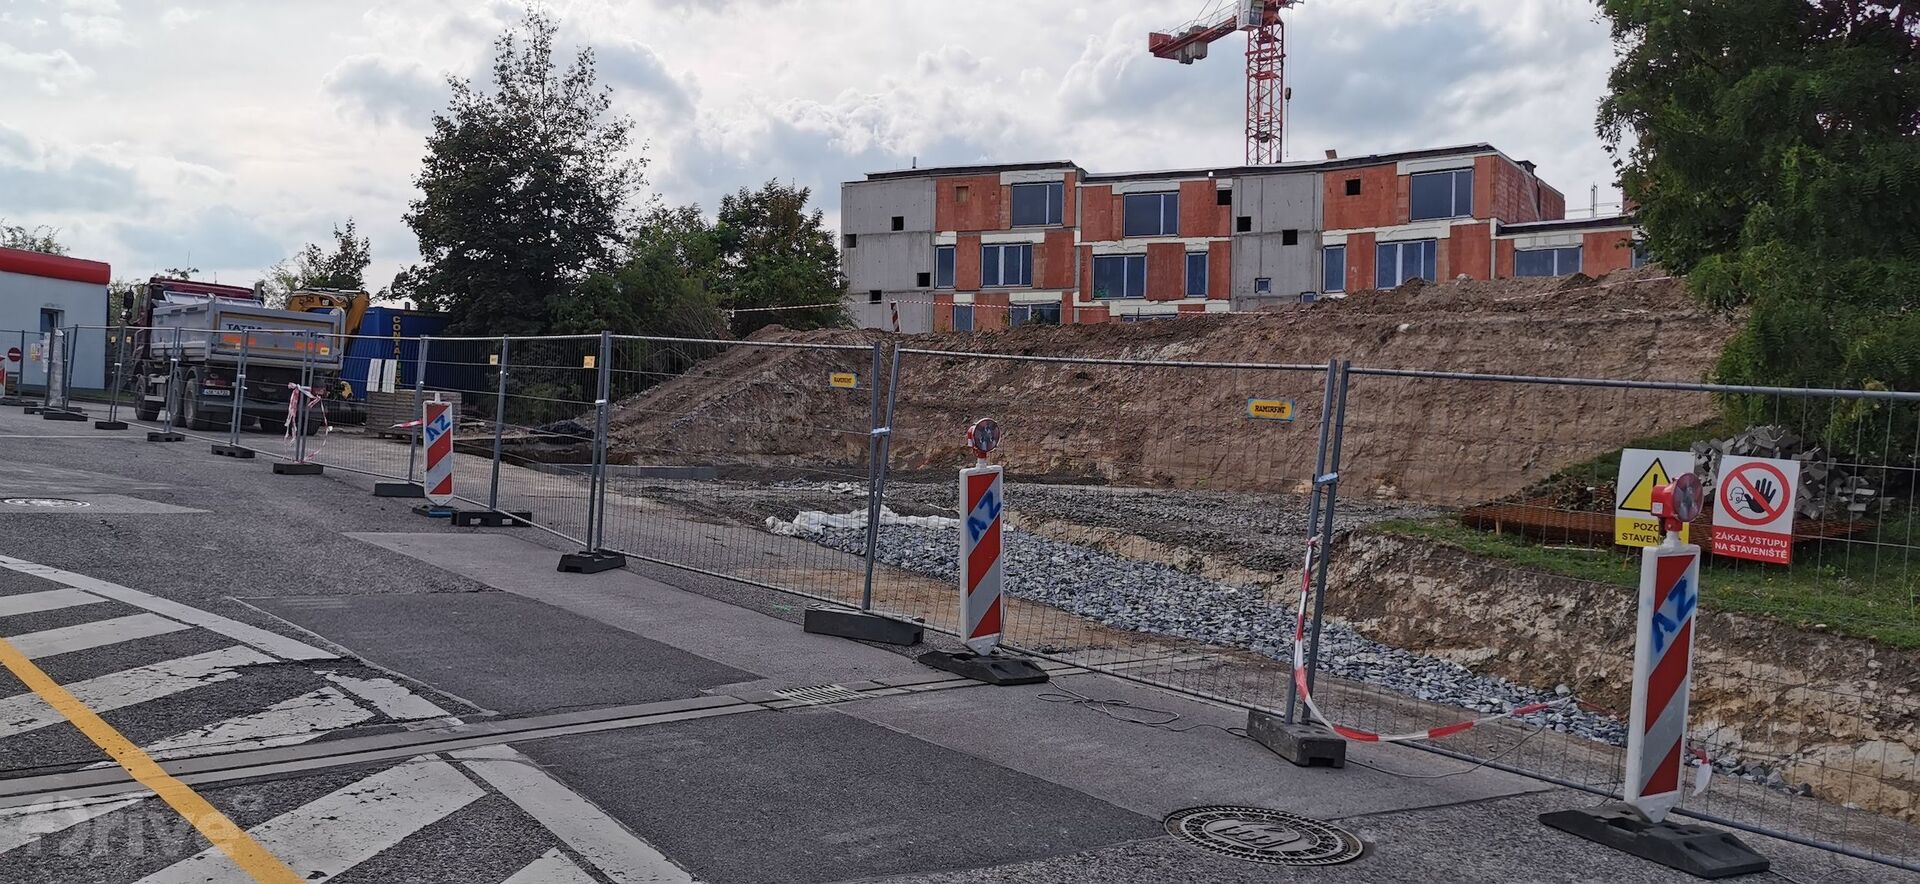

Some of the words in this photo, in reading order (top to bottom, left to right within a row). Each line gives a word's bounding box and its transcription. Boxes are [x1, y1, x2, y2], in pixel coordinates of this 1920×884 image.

[967, 489, 1001, 542] AZ
[1633, 522, 1660, 532] POZO
[1715, 531, 1747, 543] ZÁKAZ
[1749, 536, 1788, 548] VSTUPU
[1714, 542, 1728, 551] NA
[1729, 544, 1788, 559] STAVENIŠTĚ
[1652, 576, 1697, 652] AZ
